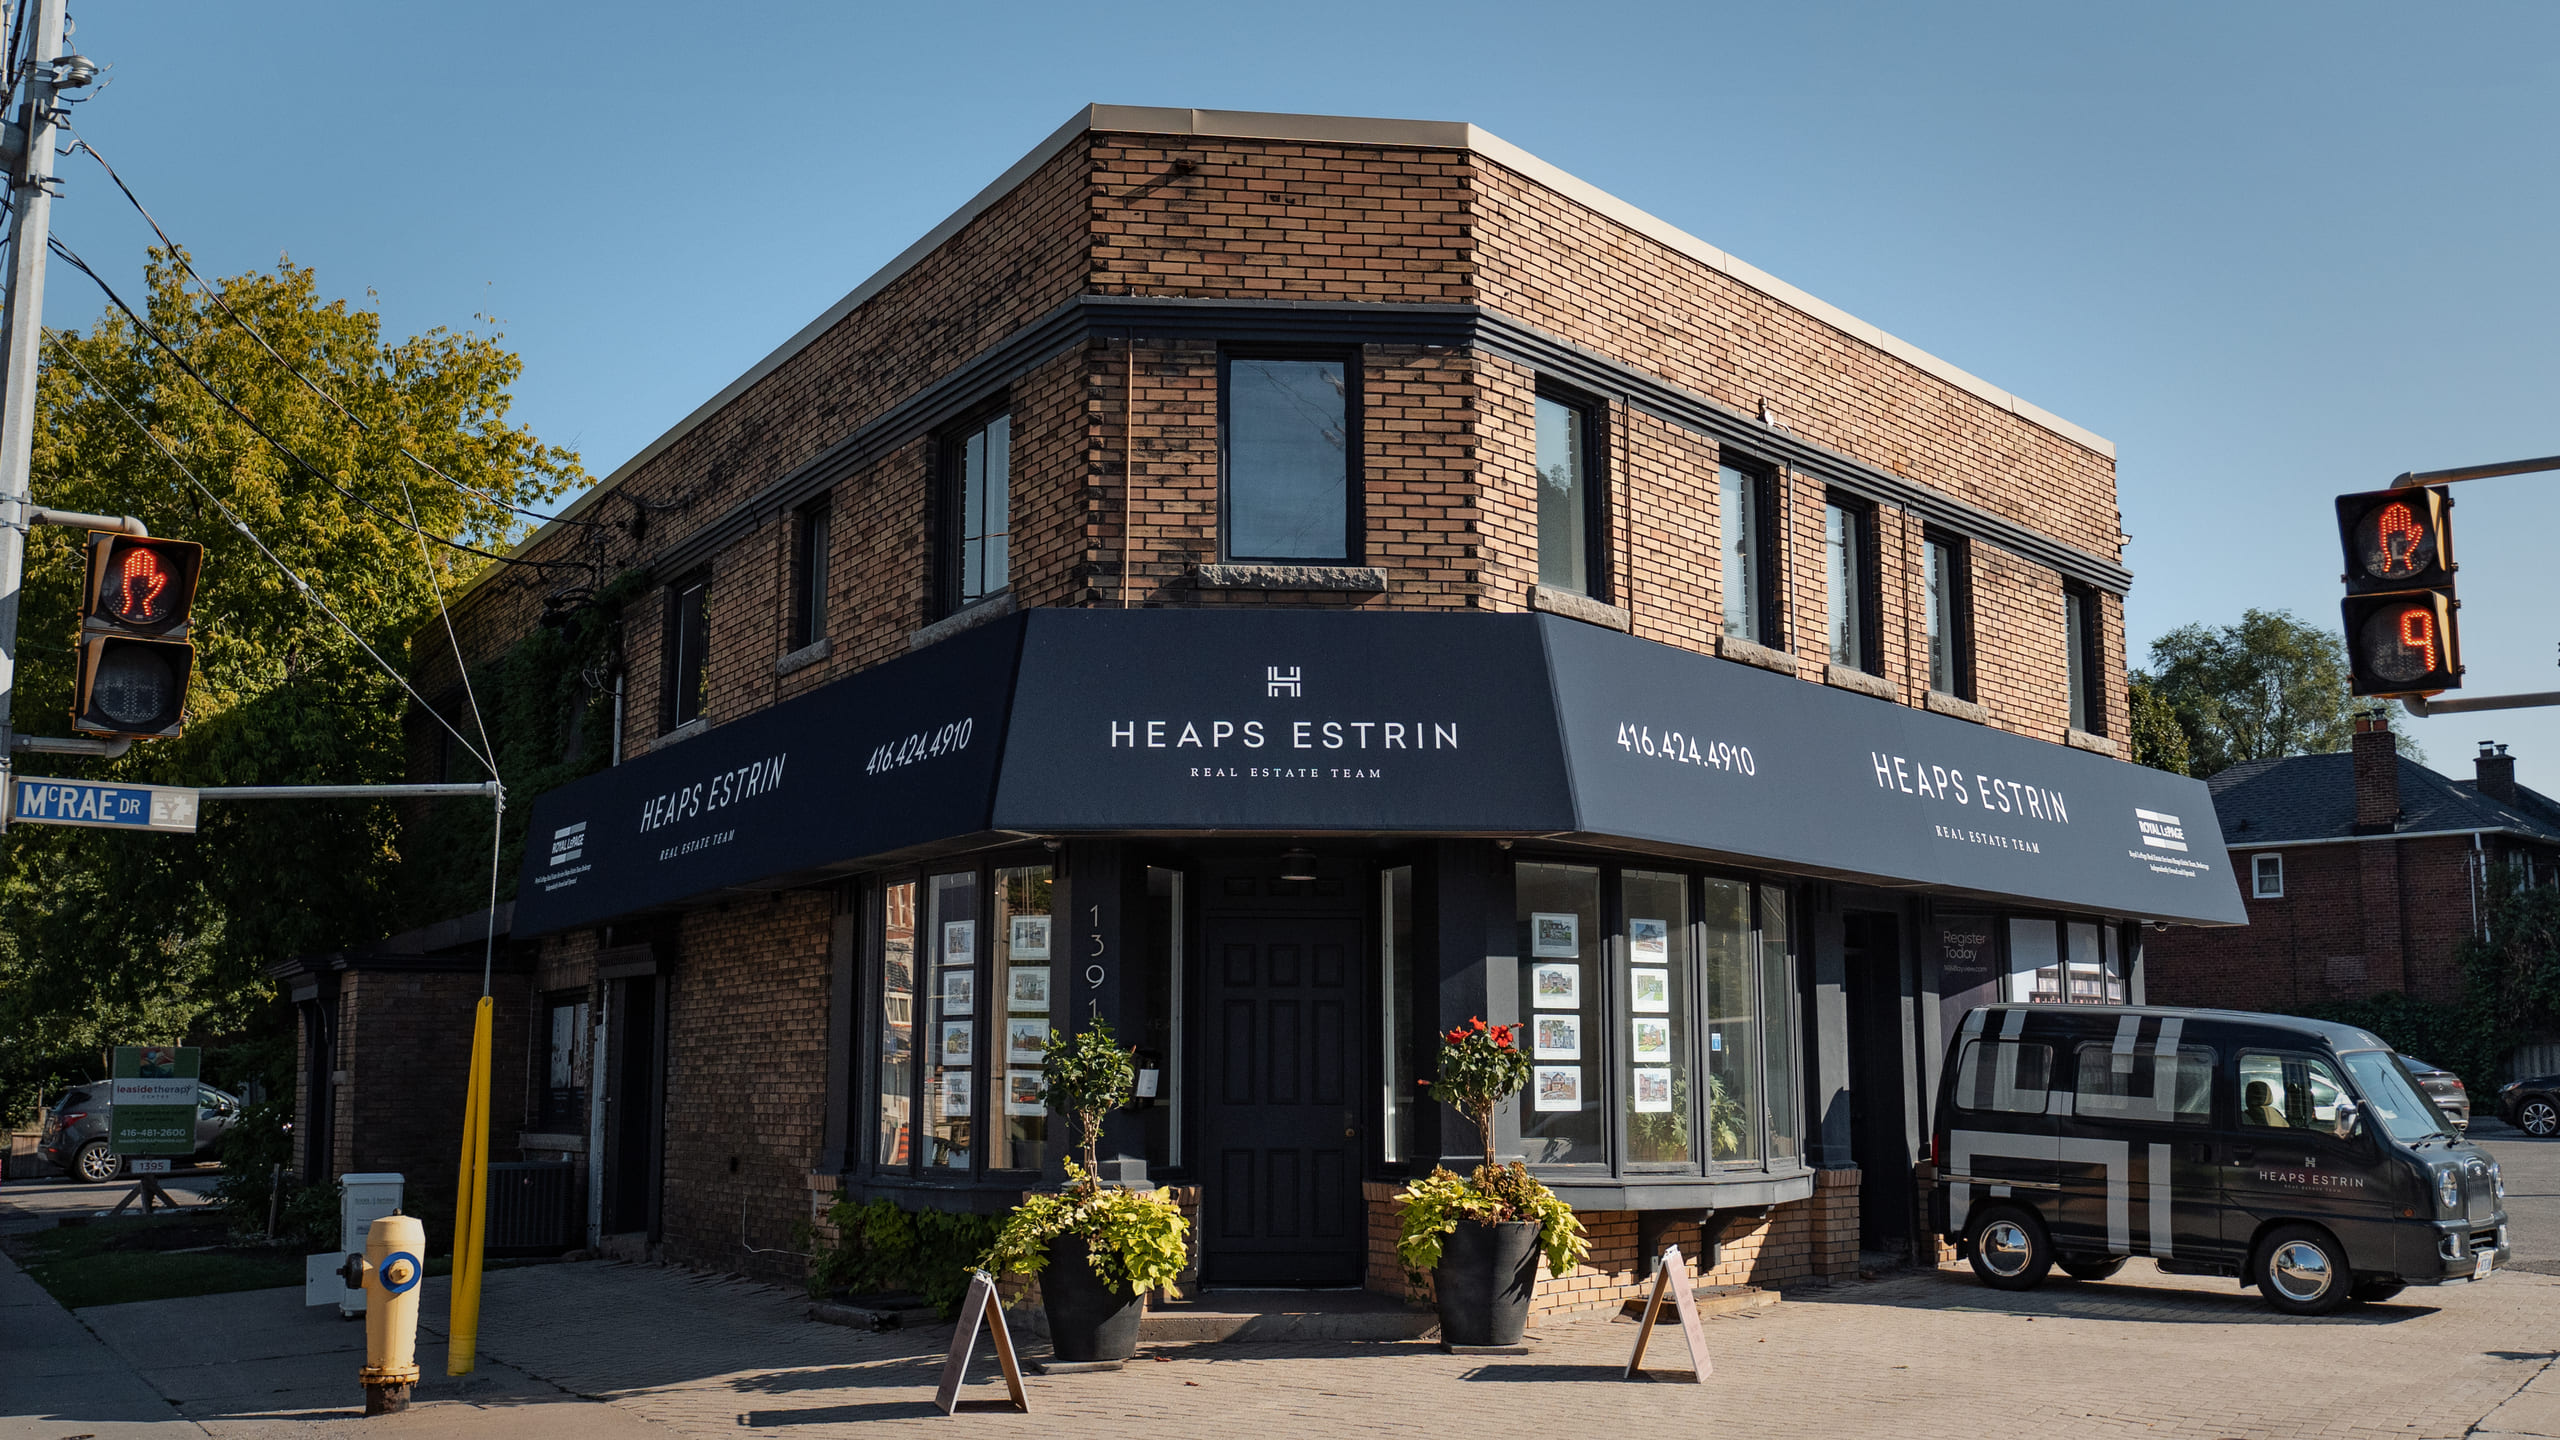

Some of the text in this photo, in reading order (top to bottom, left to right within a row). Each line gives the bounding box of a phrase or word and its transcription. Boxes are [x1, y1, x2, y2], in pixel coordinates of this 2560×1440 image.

[2401, 610, 2435, 671] 9
[866, 717, 973, 776] 416.424.4910
[1111, 720, 1458, 749] HEAPS ESTRIN
[1617, 721, 1756, 777] 416.424.4910
[1190, 767, 1382, 778] REAL ESTATE TEAM
[640, 752, 787, 833] HEAPS ESTRIN
[1871, 751, 2069, 824] HEAPS ESTRIN
[119, 798, 141, 815] DR
[659, 828, 736, 861] REAL ESTATE TEAM
[1935, 825, 2041, 855] REAL ESTATE TEAM
[1943, 931, 1986, 947] Register
[1943, 946, 1977, 962] Today
[140, 1162, 164, 1171] 1395
[2259, 1170, 2364, 1188] HEAPS ESTRIN
